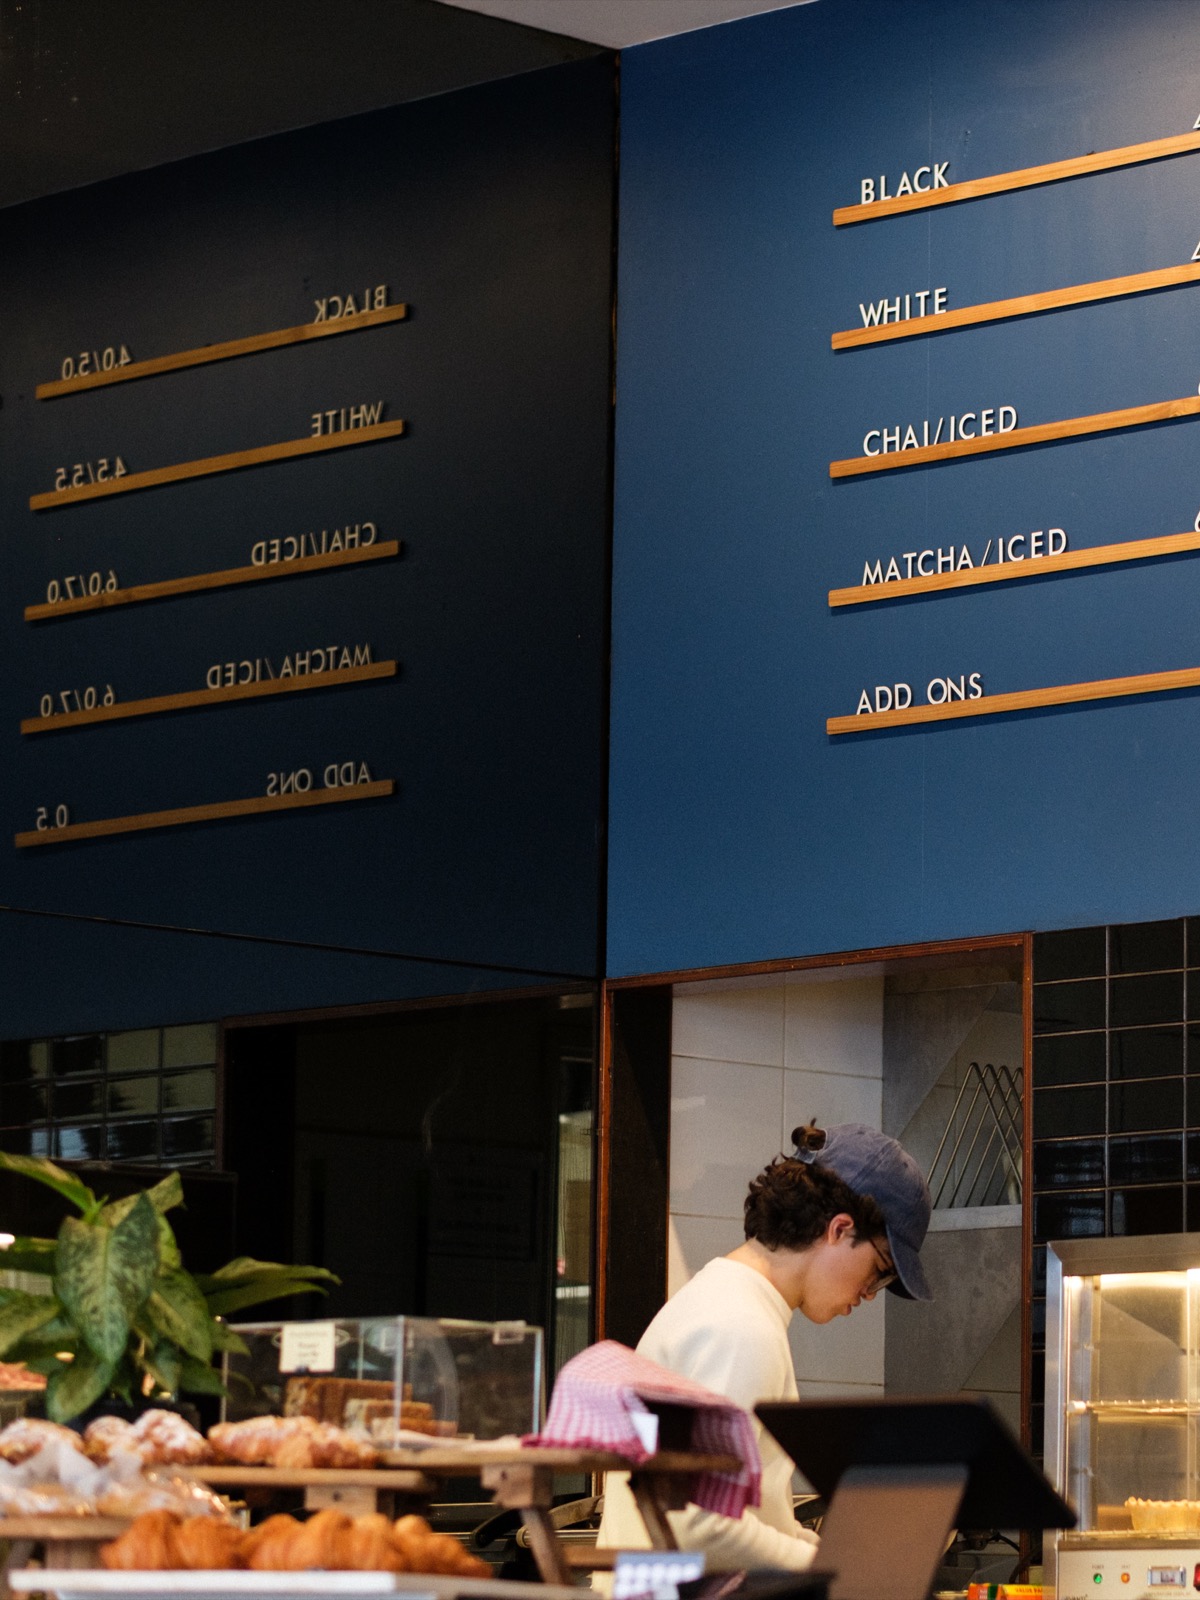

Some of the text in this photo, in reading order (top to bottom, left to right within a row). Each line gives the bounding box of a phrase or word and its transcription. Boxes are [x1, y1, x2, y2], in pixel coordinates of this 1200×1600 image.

[861, 161, 950, 205] BLACK
[859, 287, 948, 328] WHITE
[863, 406, 1018, 457] CHAI/ICED
[862, 528, 1068, 586] MATCHA/ICED
[856, 672, 983, 715] ADD ONS
